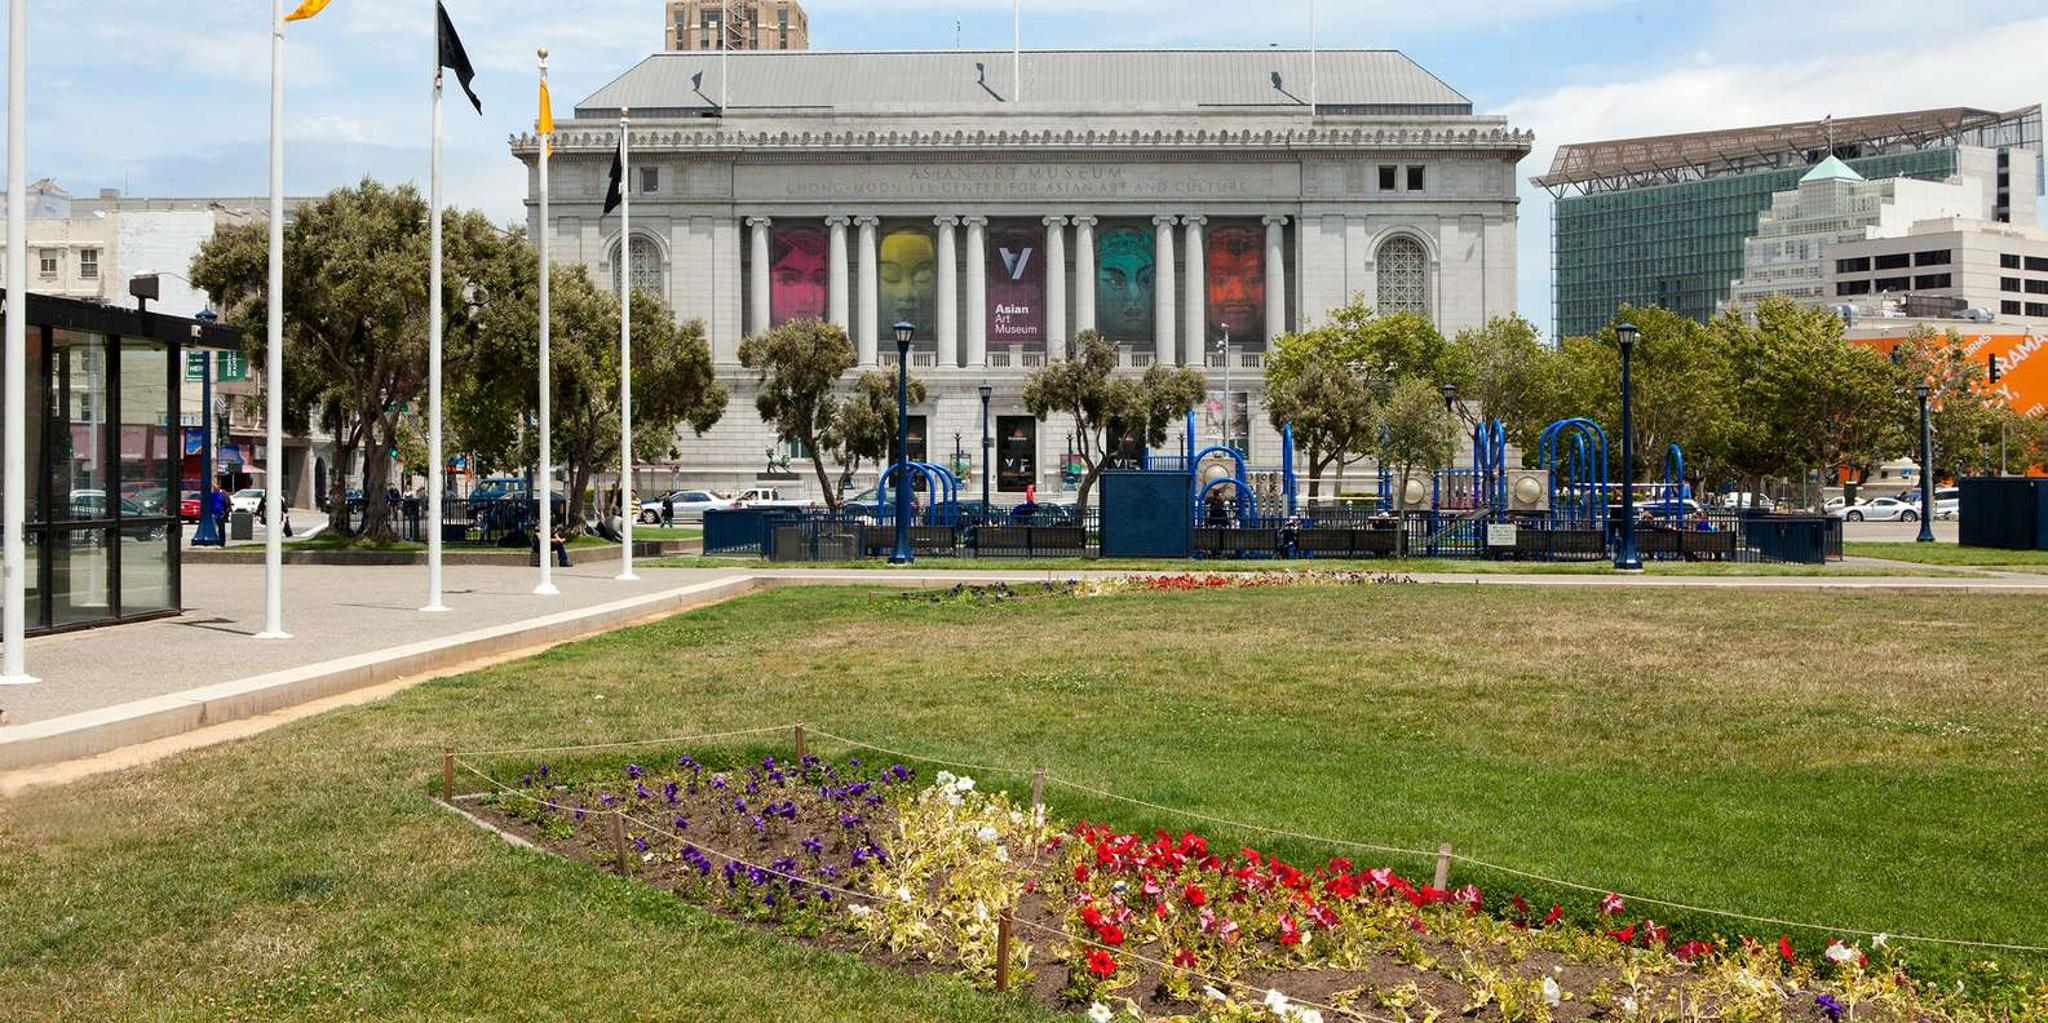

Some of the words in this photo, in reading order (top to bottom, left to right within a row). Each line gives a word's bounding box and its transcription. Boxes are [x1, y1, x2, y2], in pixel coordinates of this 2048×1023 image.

[910, 167, 972, 179] ASIAN
[980, 167, 1016, 179] ART
[1029, 166, 1122, 179] MUSEUM
[942, 181, 1001, 193] CENTER
[1008, 181, 1038, 193] FOR
[1046, 181, 1092, 193] ASIAN
[1101, 181, 1126, 193] ART
[1134, 181, 1168, 193] AND
[1175, 181, 1248, 193] CULTURE
[995, 304, 1029, 314] Asian
[995, 314, 1010, 323] Art
[995, 324, 1038, 334] Museum
